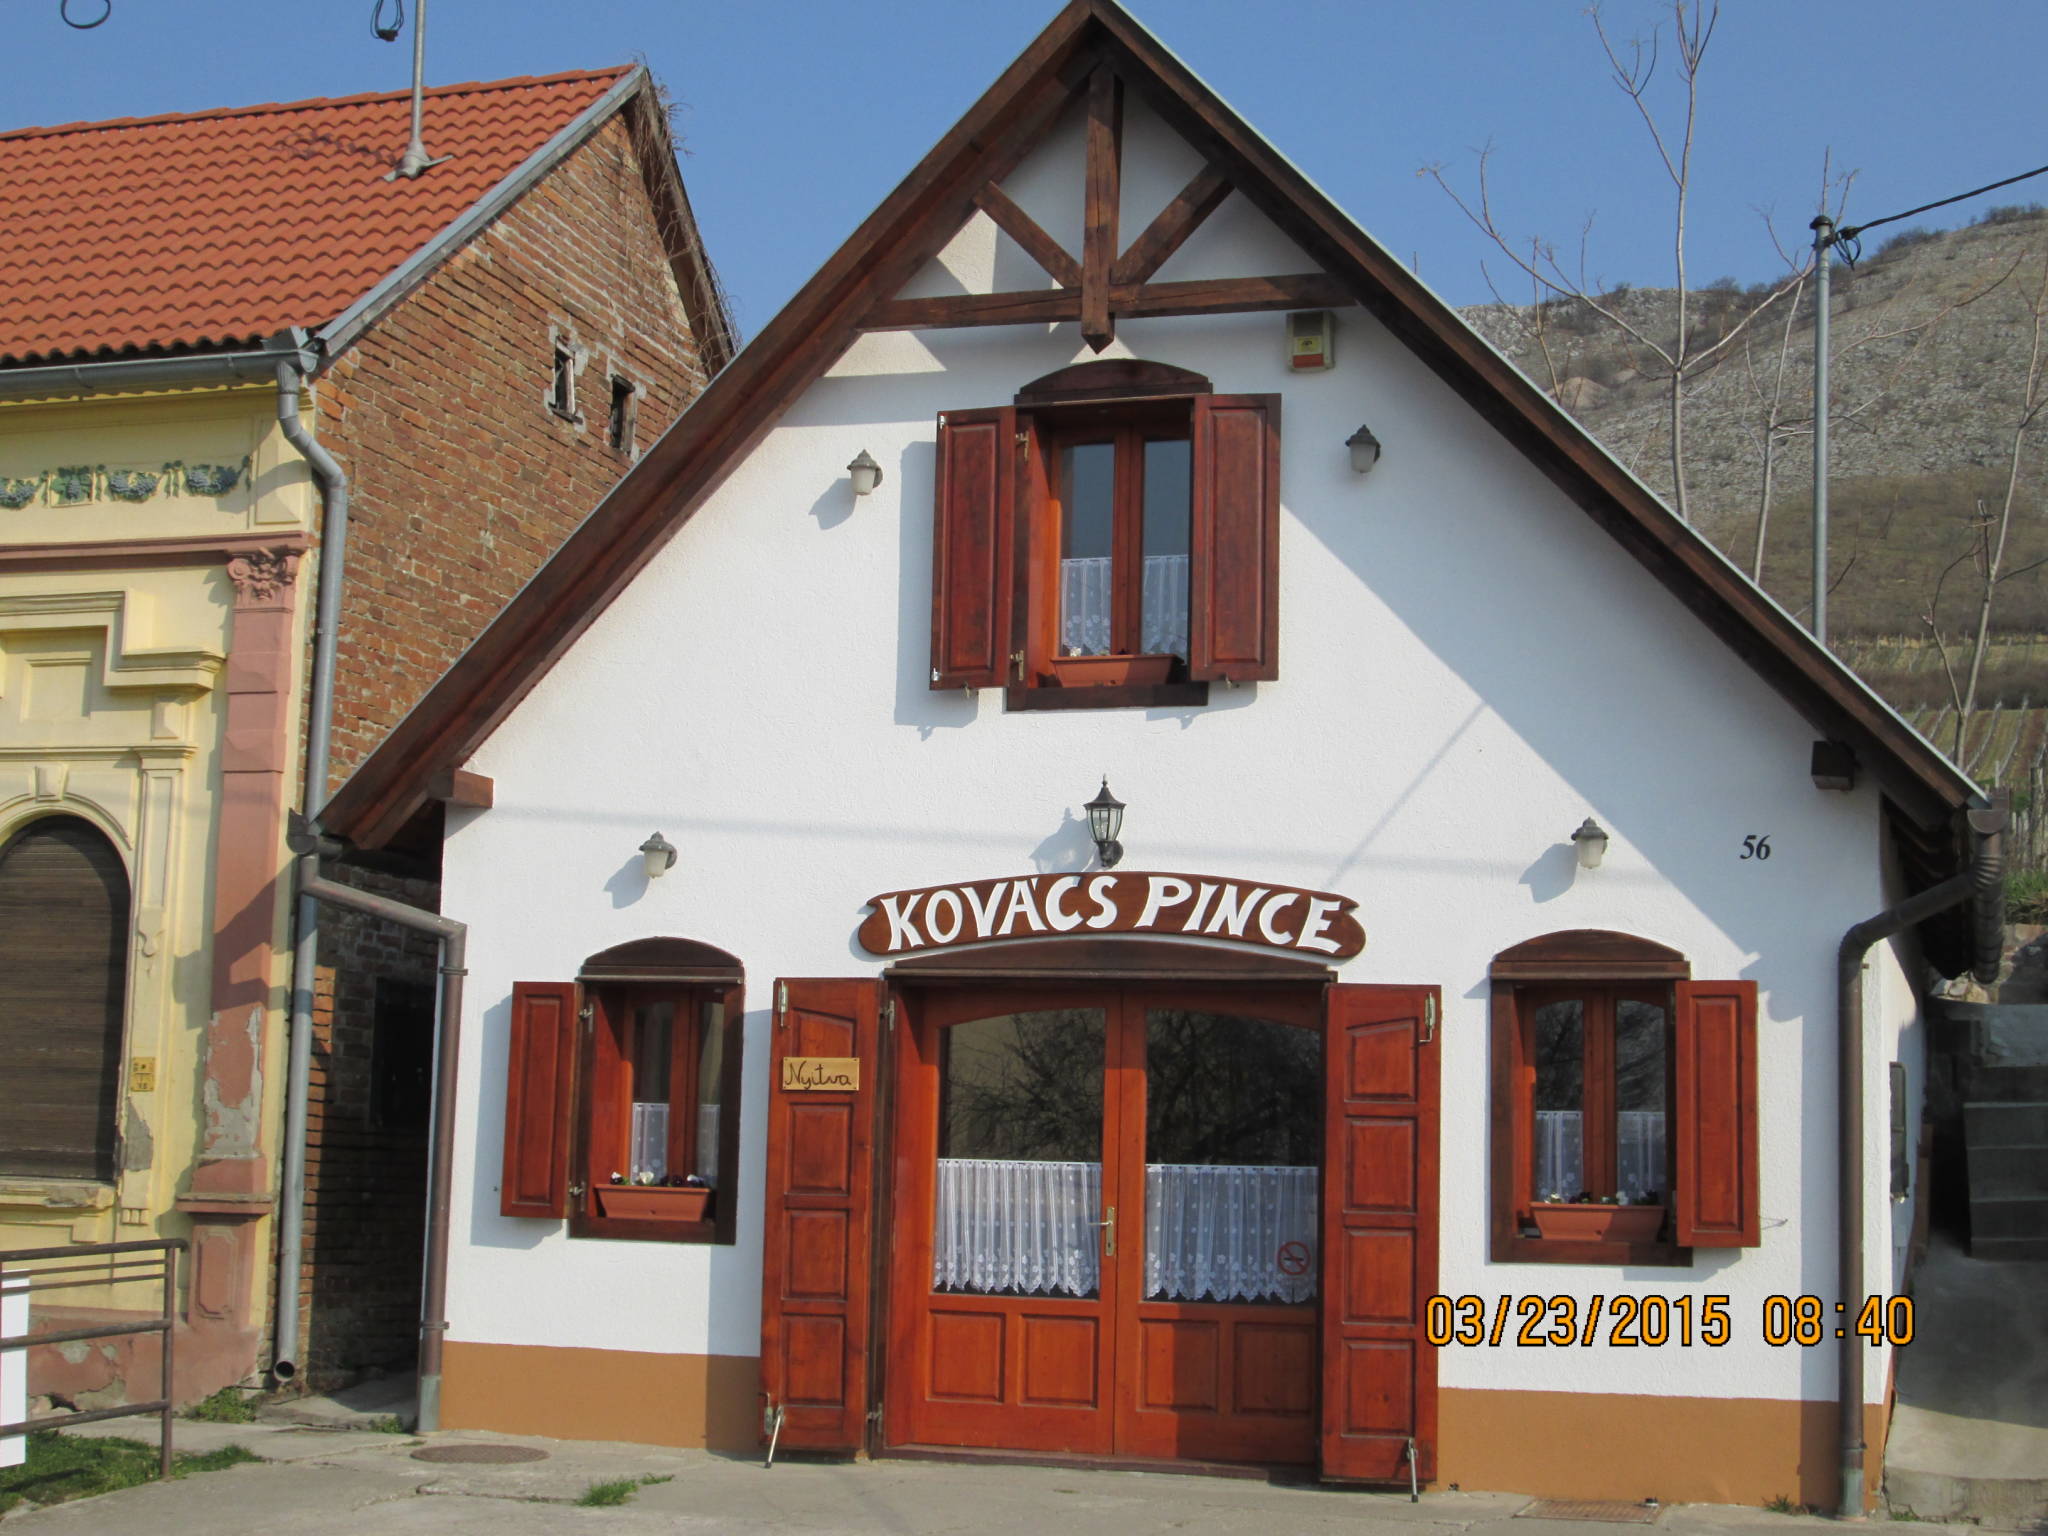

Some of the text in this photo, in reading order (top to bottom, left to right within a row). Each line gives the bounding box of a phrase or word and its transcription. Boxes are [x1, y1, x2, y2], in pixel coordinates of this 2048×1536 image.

[1740, 834, 1771, 860] 56
[880, 875, 1342, 954] KOVÁCS PINCE
[784, 1060, 852, 1090] Nyitva
